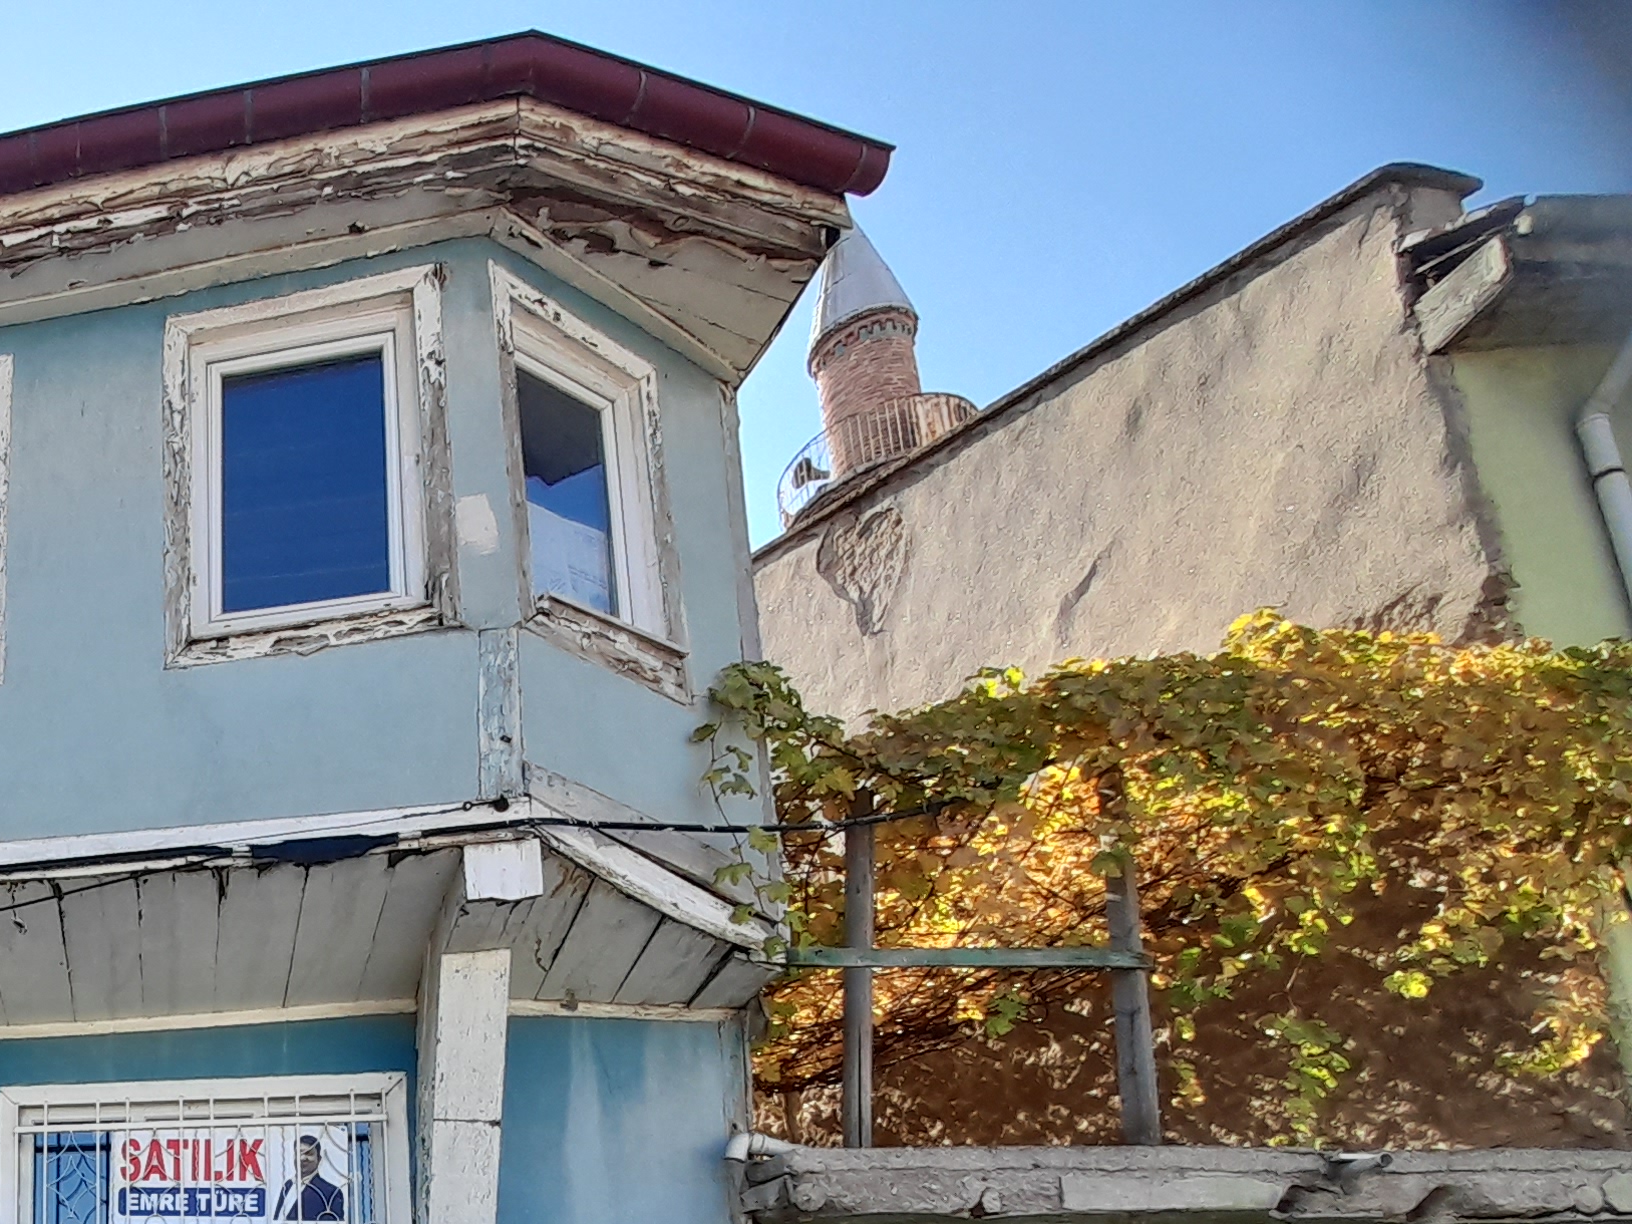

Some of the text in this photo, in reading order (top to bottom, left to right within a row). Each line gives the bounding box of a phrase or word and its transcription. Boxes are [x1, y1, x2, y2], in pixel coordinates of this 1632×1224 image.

[120, 1138, 264, 1182] SATILIK
[129, 1190, 259, 1212] EMRE TÜRE
